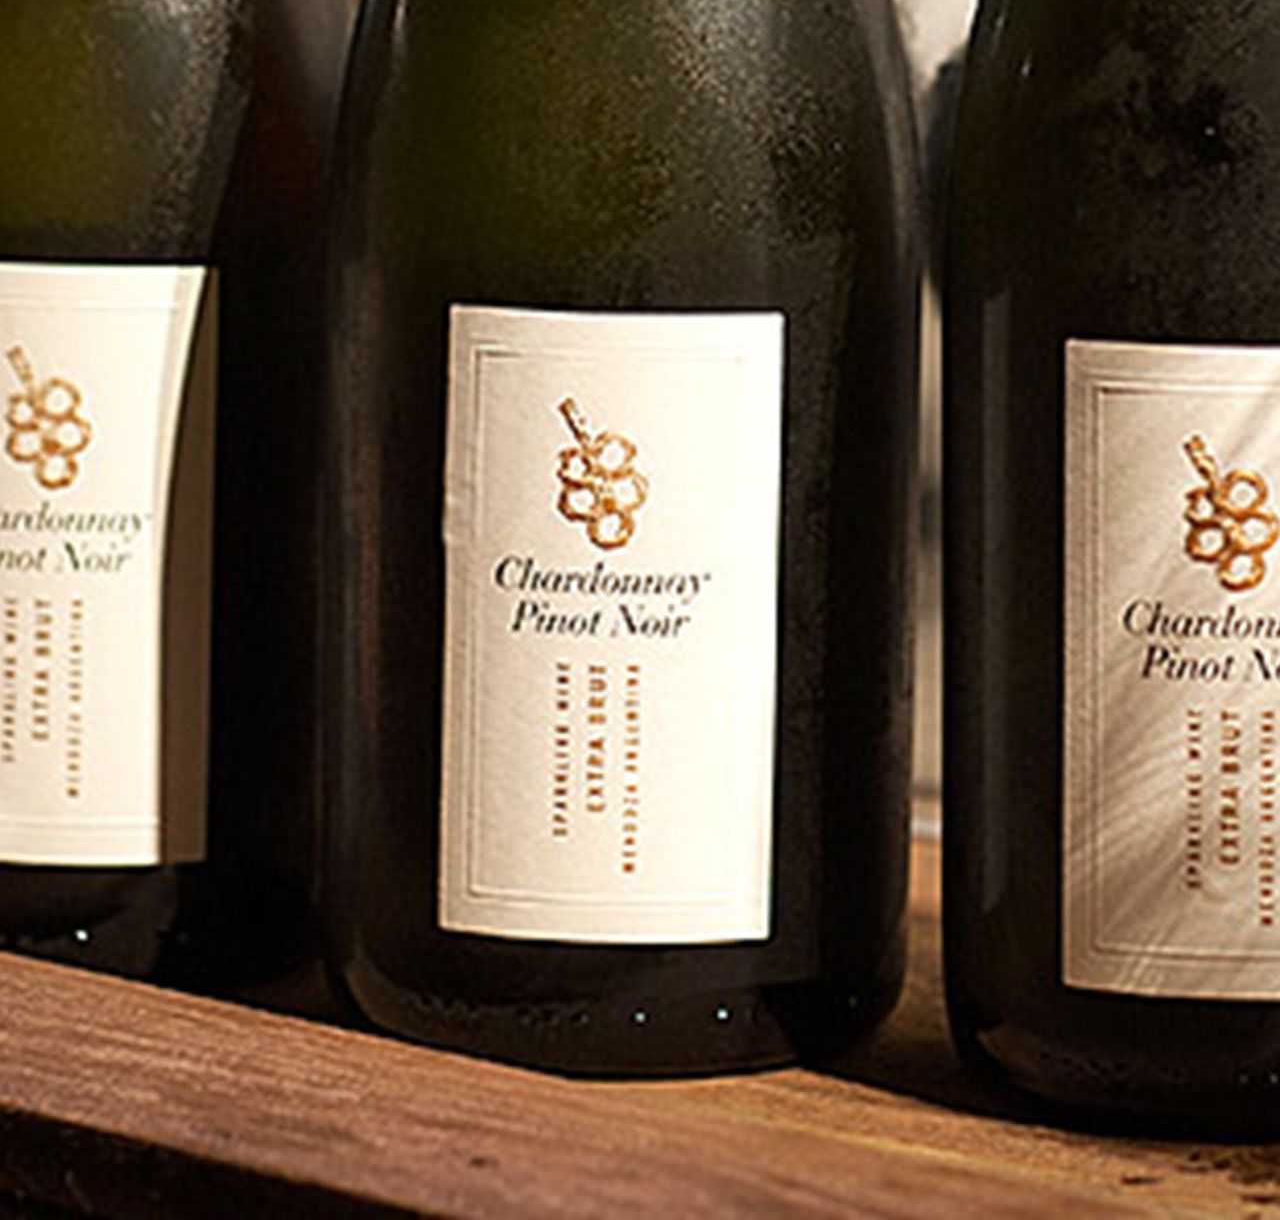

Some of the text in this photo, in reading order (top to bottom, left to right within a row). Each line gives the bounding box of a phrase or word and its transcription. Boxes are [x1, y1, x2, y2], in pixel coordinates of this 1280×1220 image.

[56, 541, 132, 573] Noir
[495, 555, 712, 604] Chardonnay
[512, 600, 691, 637] Pinot Noir
[31, 599, 52, 742] EXTRA BRUT
[1142, 645, 1234, 682] Pinot
[585, 665, 608, 814] EXTRA BRUT
[1218, 710, 1241, 866] EXTRA BRUT
